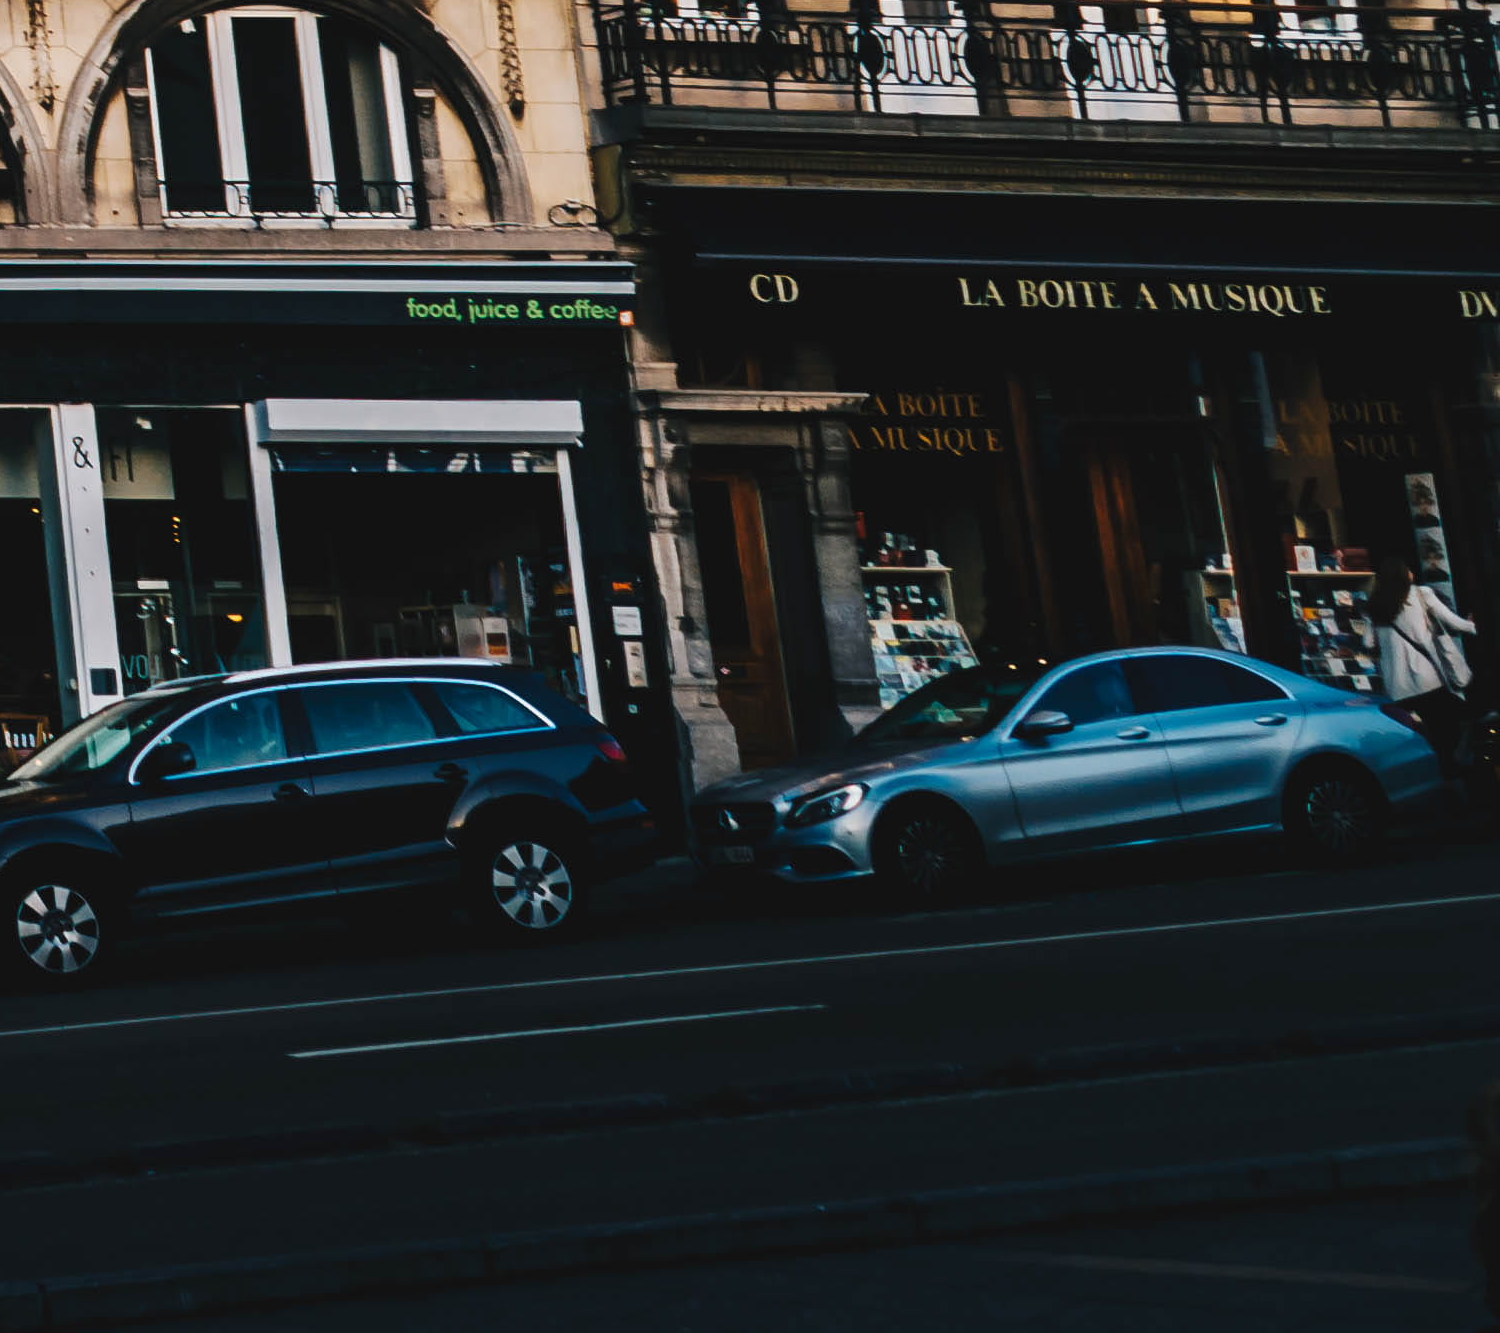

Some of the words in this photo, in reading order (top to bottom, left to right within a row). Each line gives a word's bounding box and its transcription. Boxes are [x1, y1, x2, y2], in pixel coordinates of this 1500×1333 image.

[750, 274, 799, 303] CD
[958, 277, 1005, 307] LA
[1017, 279, 1121, 309] BOITE
[1135, 282, 1158, 310] A
[1168, 283, 1332, 317] MUSIQUE
[406, 297, 462, 322] food,
[468, 298, 520, 324] juice
[527, 299, 545, 319] &
[550, 299, 617, 320] coffee
[72, 436, 94, 469] &
[870, 426, 1004, 457] MUSIQUE
